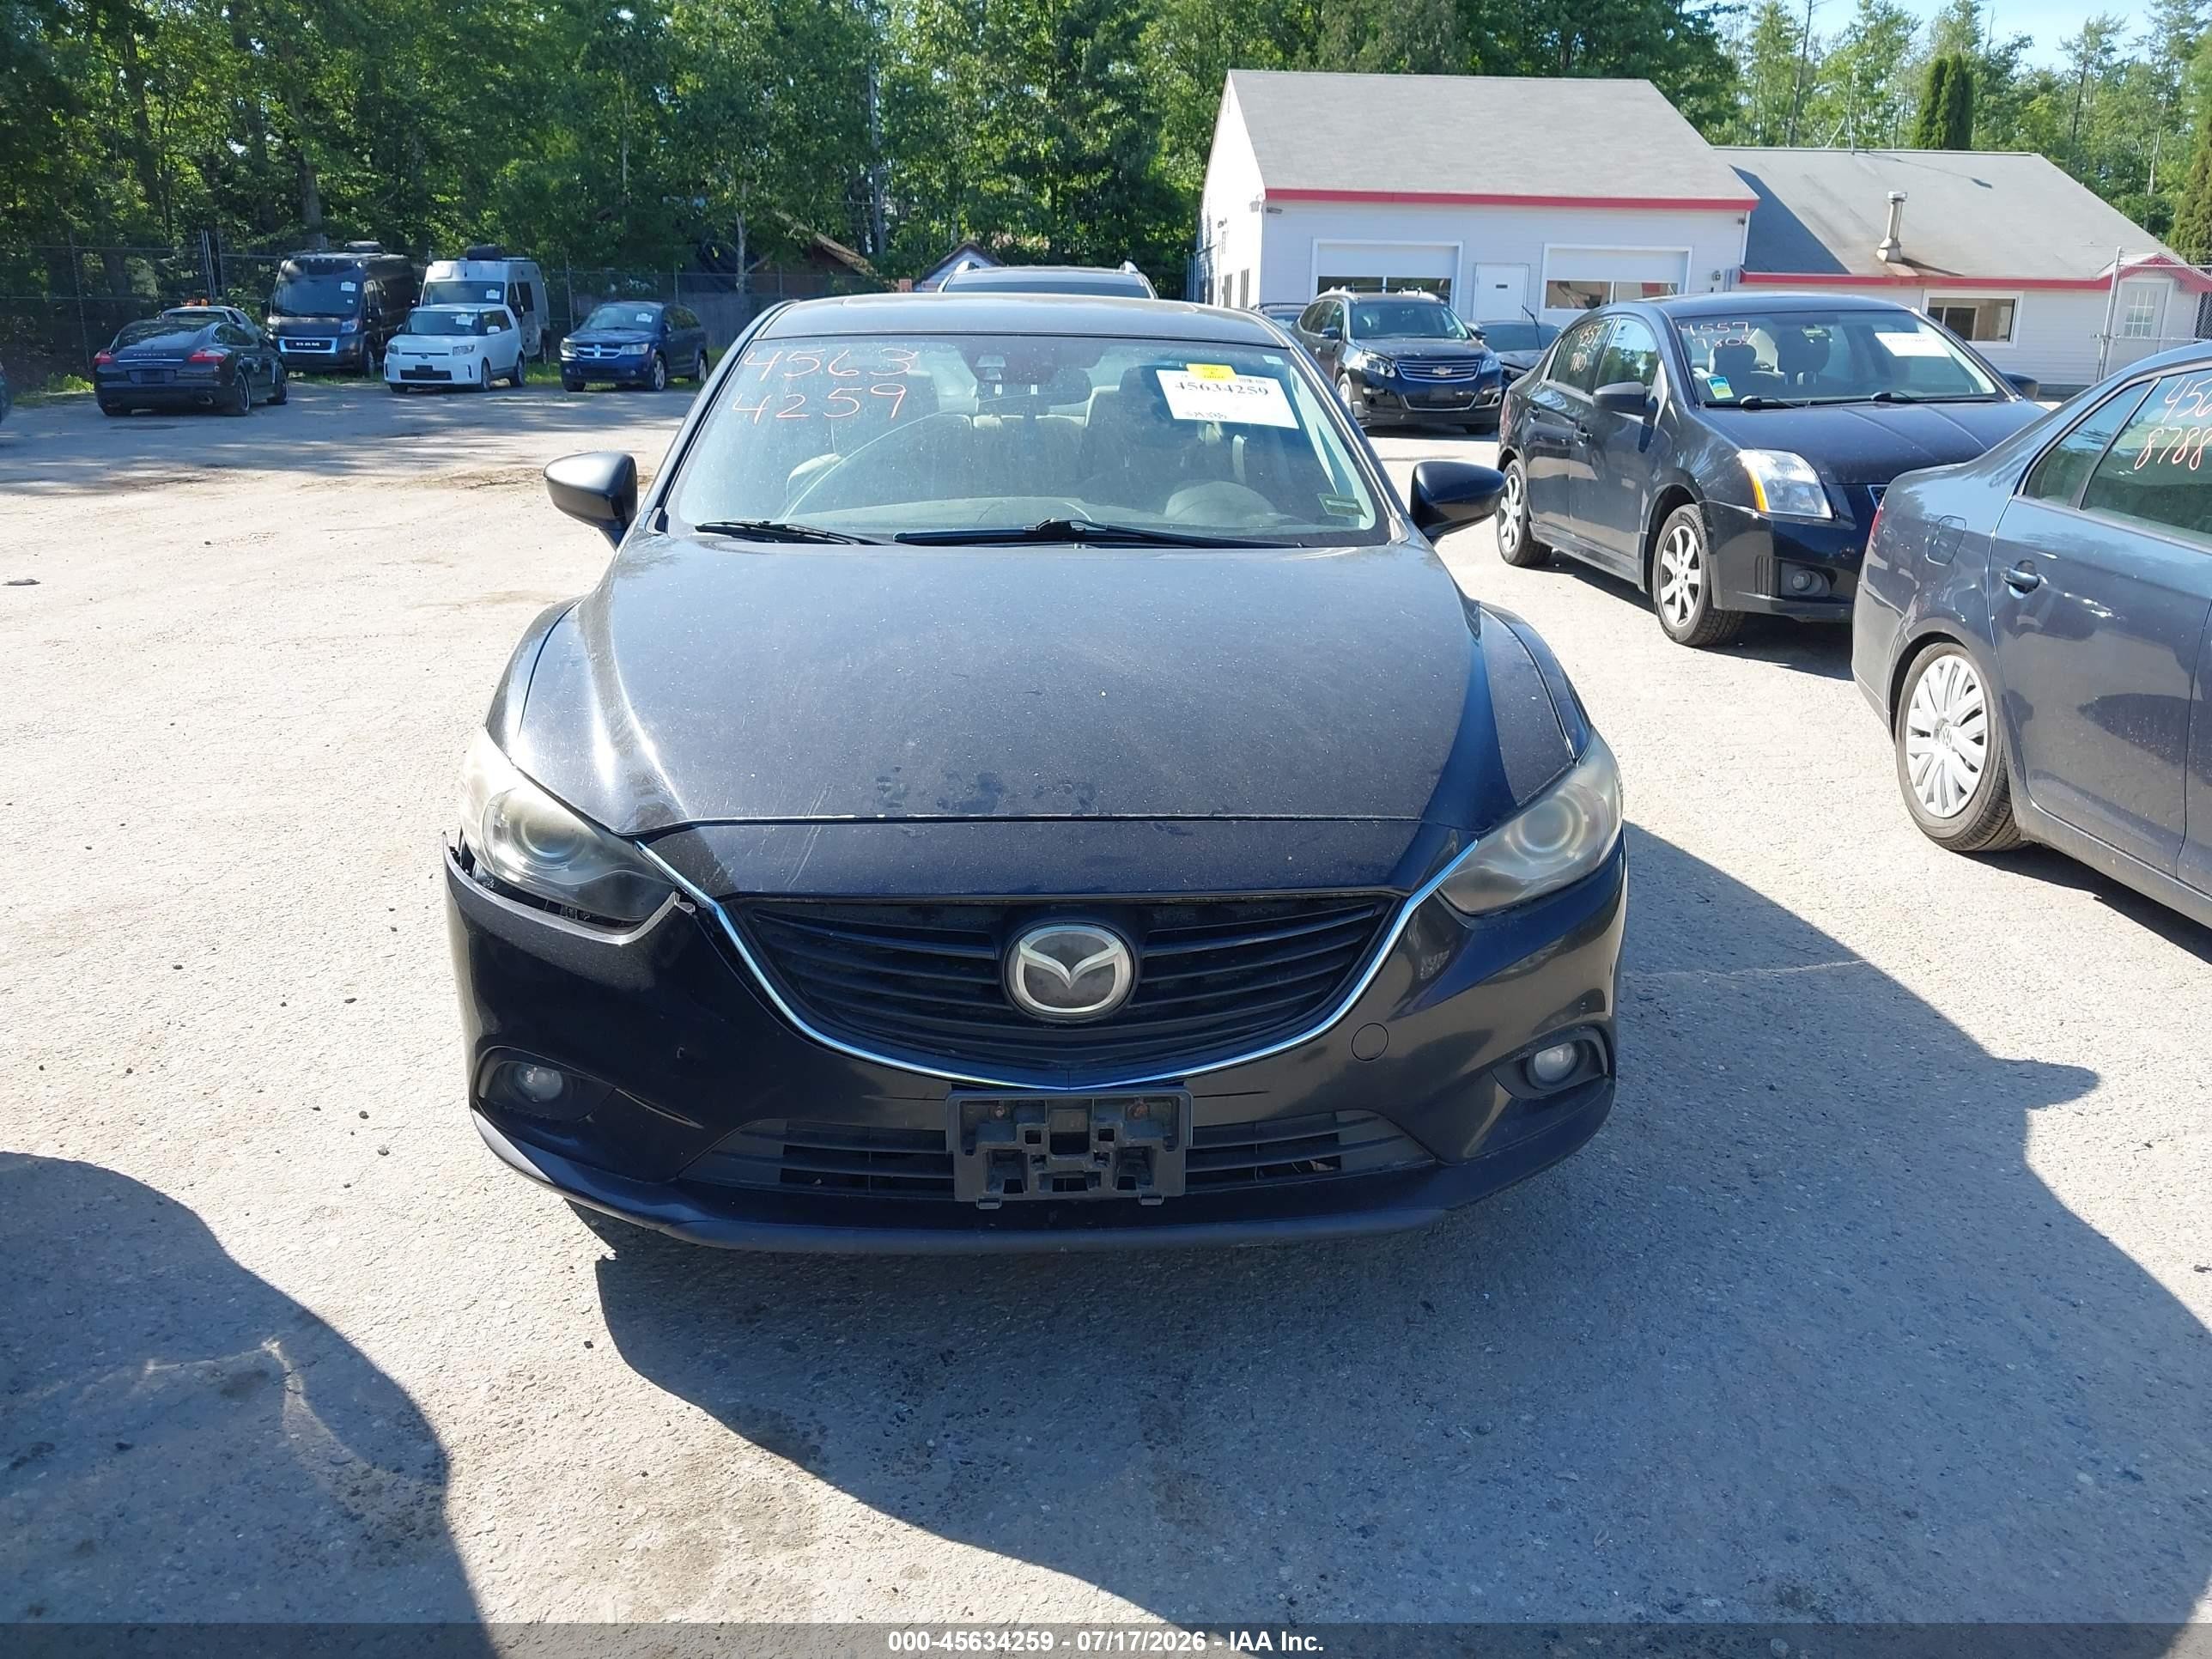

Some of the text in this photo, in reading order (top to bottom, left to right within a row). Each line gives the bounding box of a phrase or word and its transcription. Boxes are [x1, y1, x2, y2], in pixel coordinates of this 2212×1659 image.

[1678, 321, 1748, 337] 4557
[744, 347, 920, 382] 4563
[1175, 381, 1269, 395] 45634259
[732, 382, 907, 425] 4259
